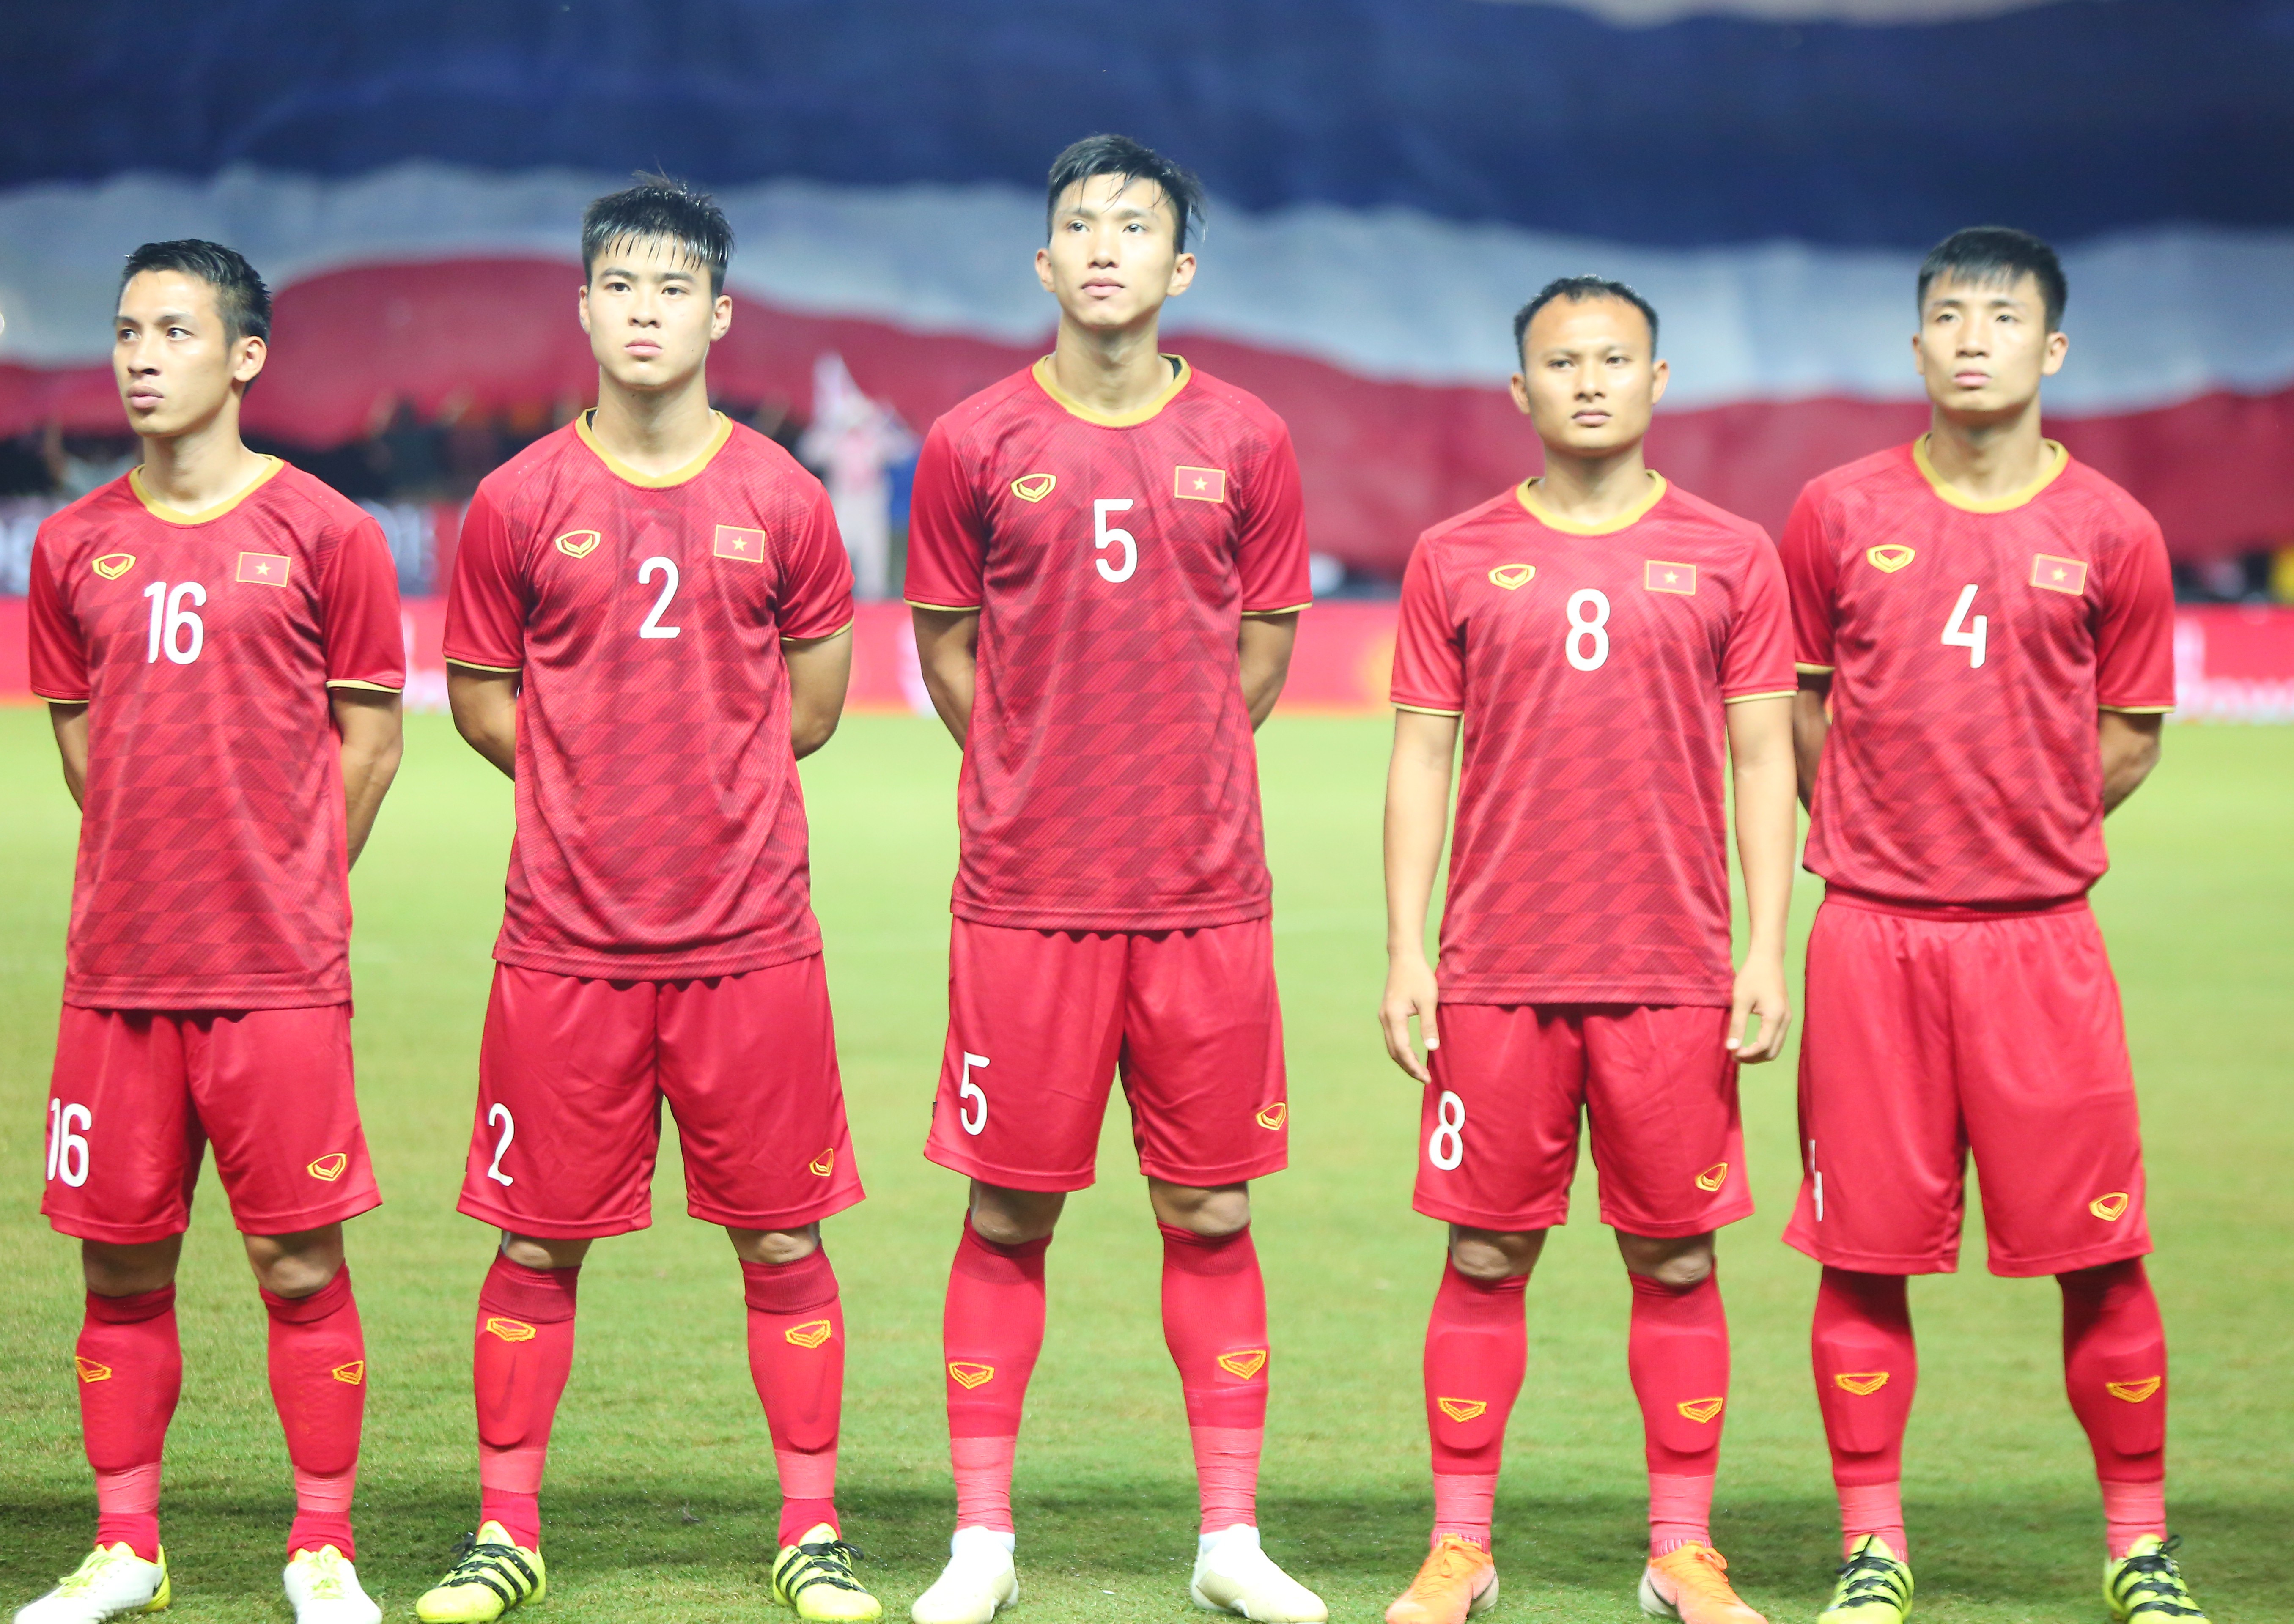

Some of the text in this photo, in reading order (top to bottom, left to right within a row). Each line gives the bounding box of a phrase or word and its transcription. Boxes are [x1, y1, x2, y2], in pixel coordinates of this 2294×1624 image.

[1093, 498, 1138, 583] 5
[143, 581, 207, 665] 16
[638, 556, 681, 639] 2
[1565, 588, 1611, 672] 8
[1940, 584, 1988, 669] 4
[960, 1051, 990, 1136] 5
[1428, 1090, 1465, 1171] 8
[47, 1097, 92, 1188] 16
[487, 1102, 515, 1187] 2
